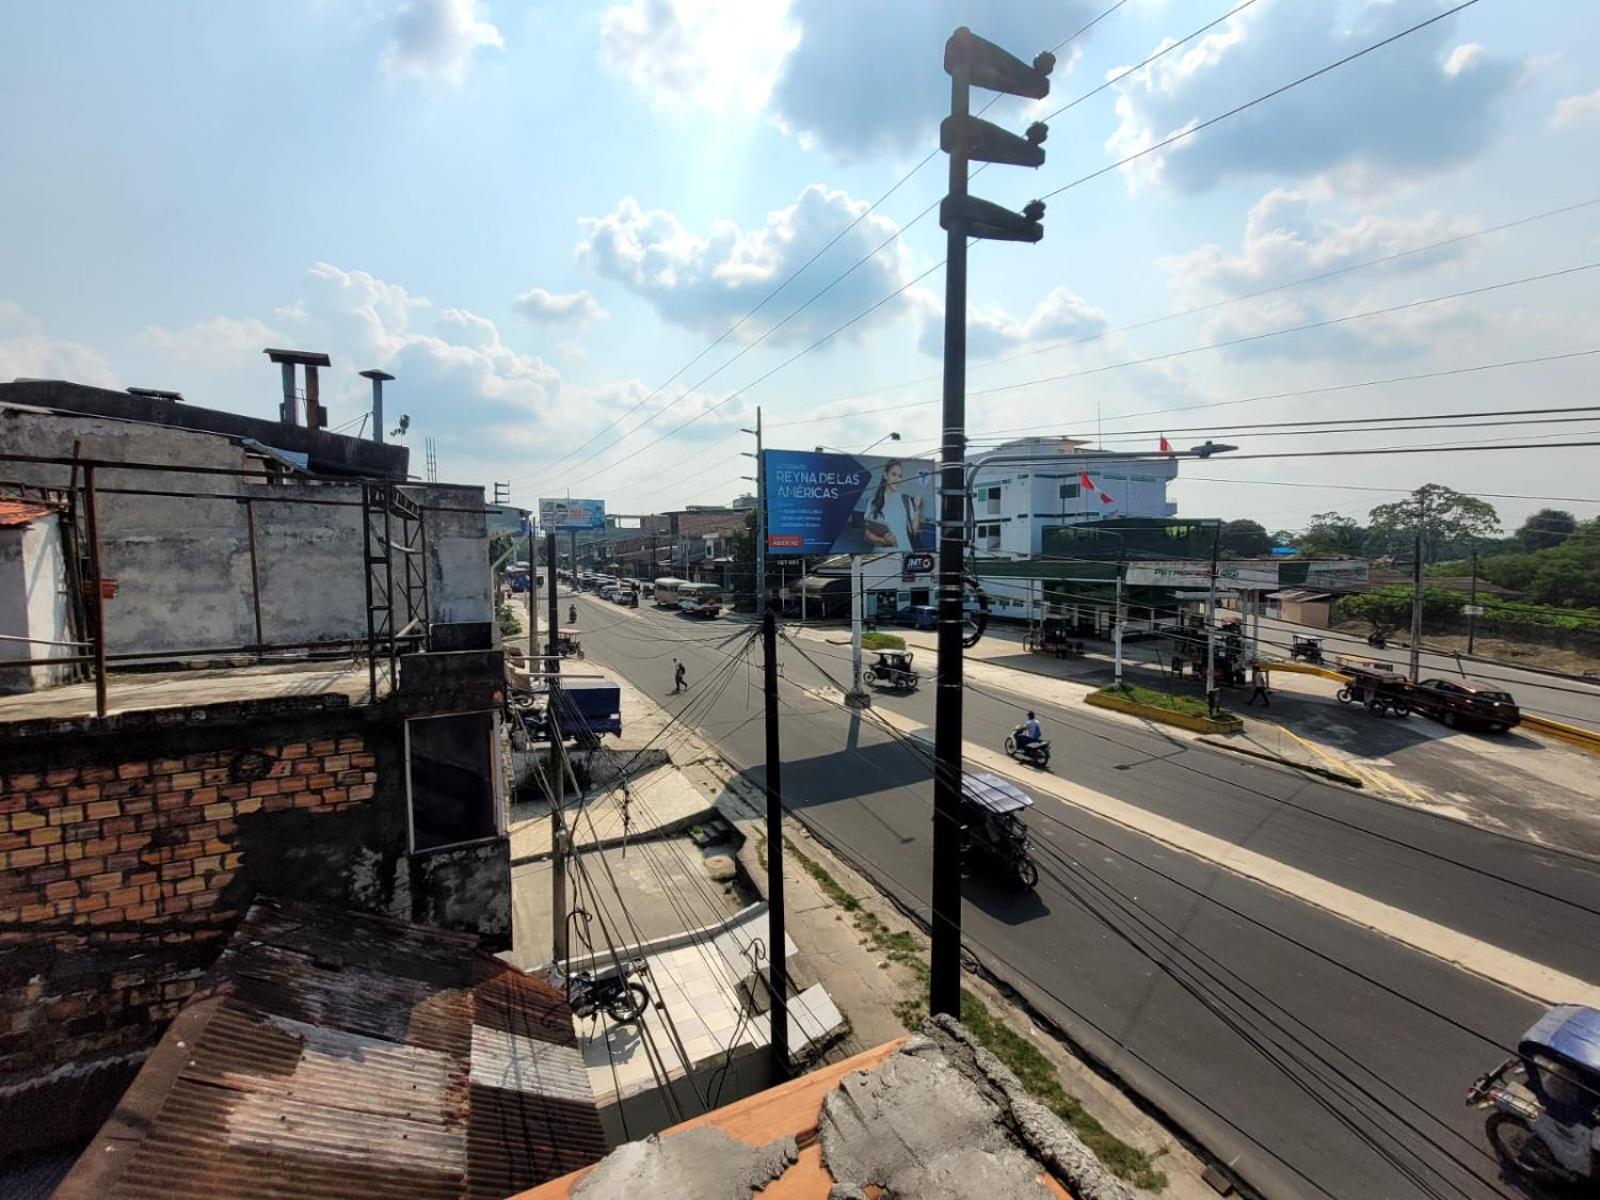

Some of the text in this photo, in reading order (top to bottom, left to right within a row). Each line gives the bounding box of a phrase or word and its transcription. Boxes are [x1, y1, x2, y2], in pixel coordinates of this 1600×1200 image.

[776, 470, 860, 486] REYNA DE LAS
